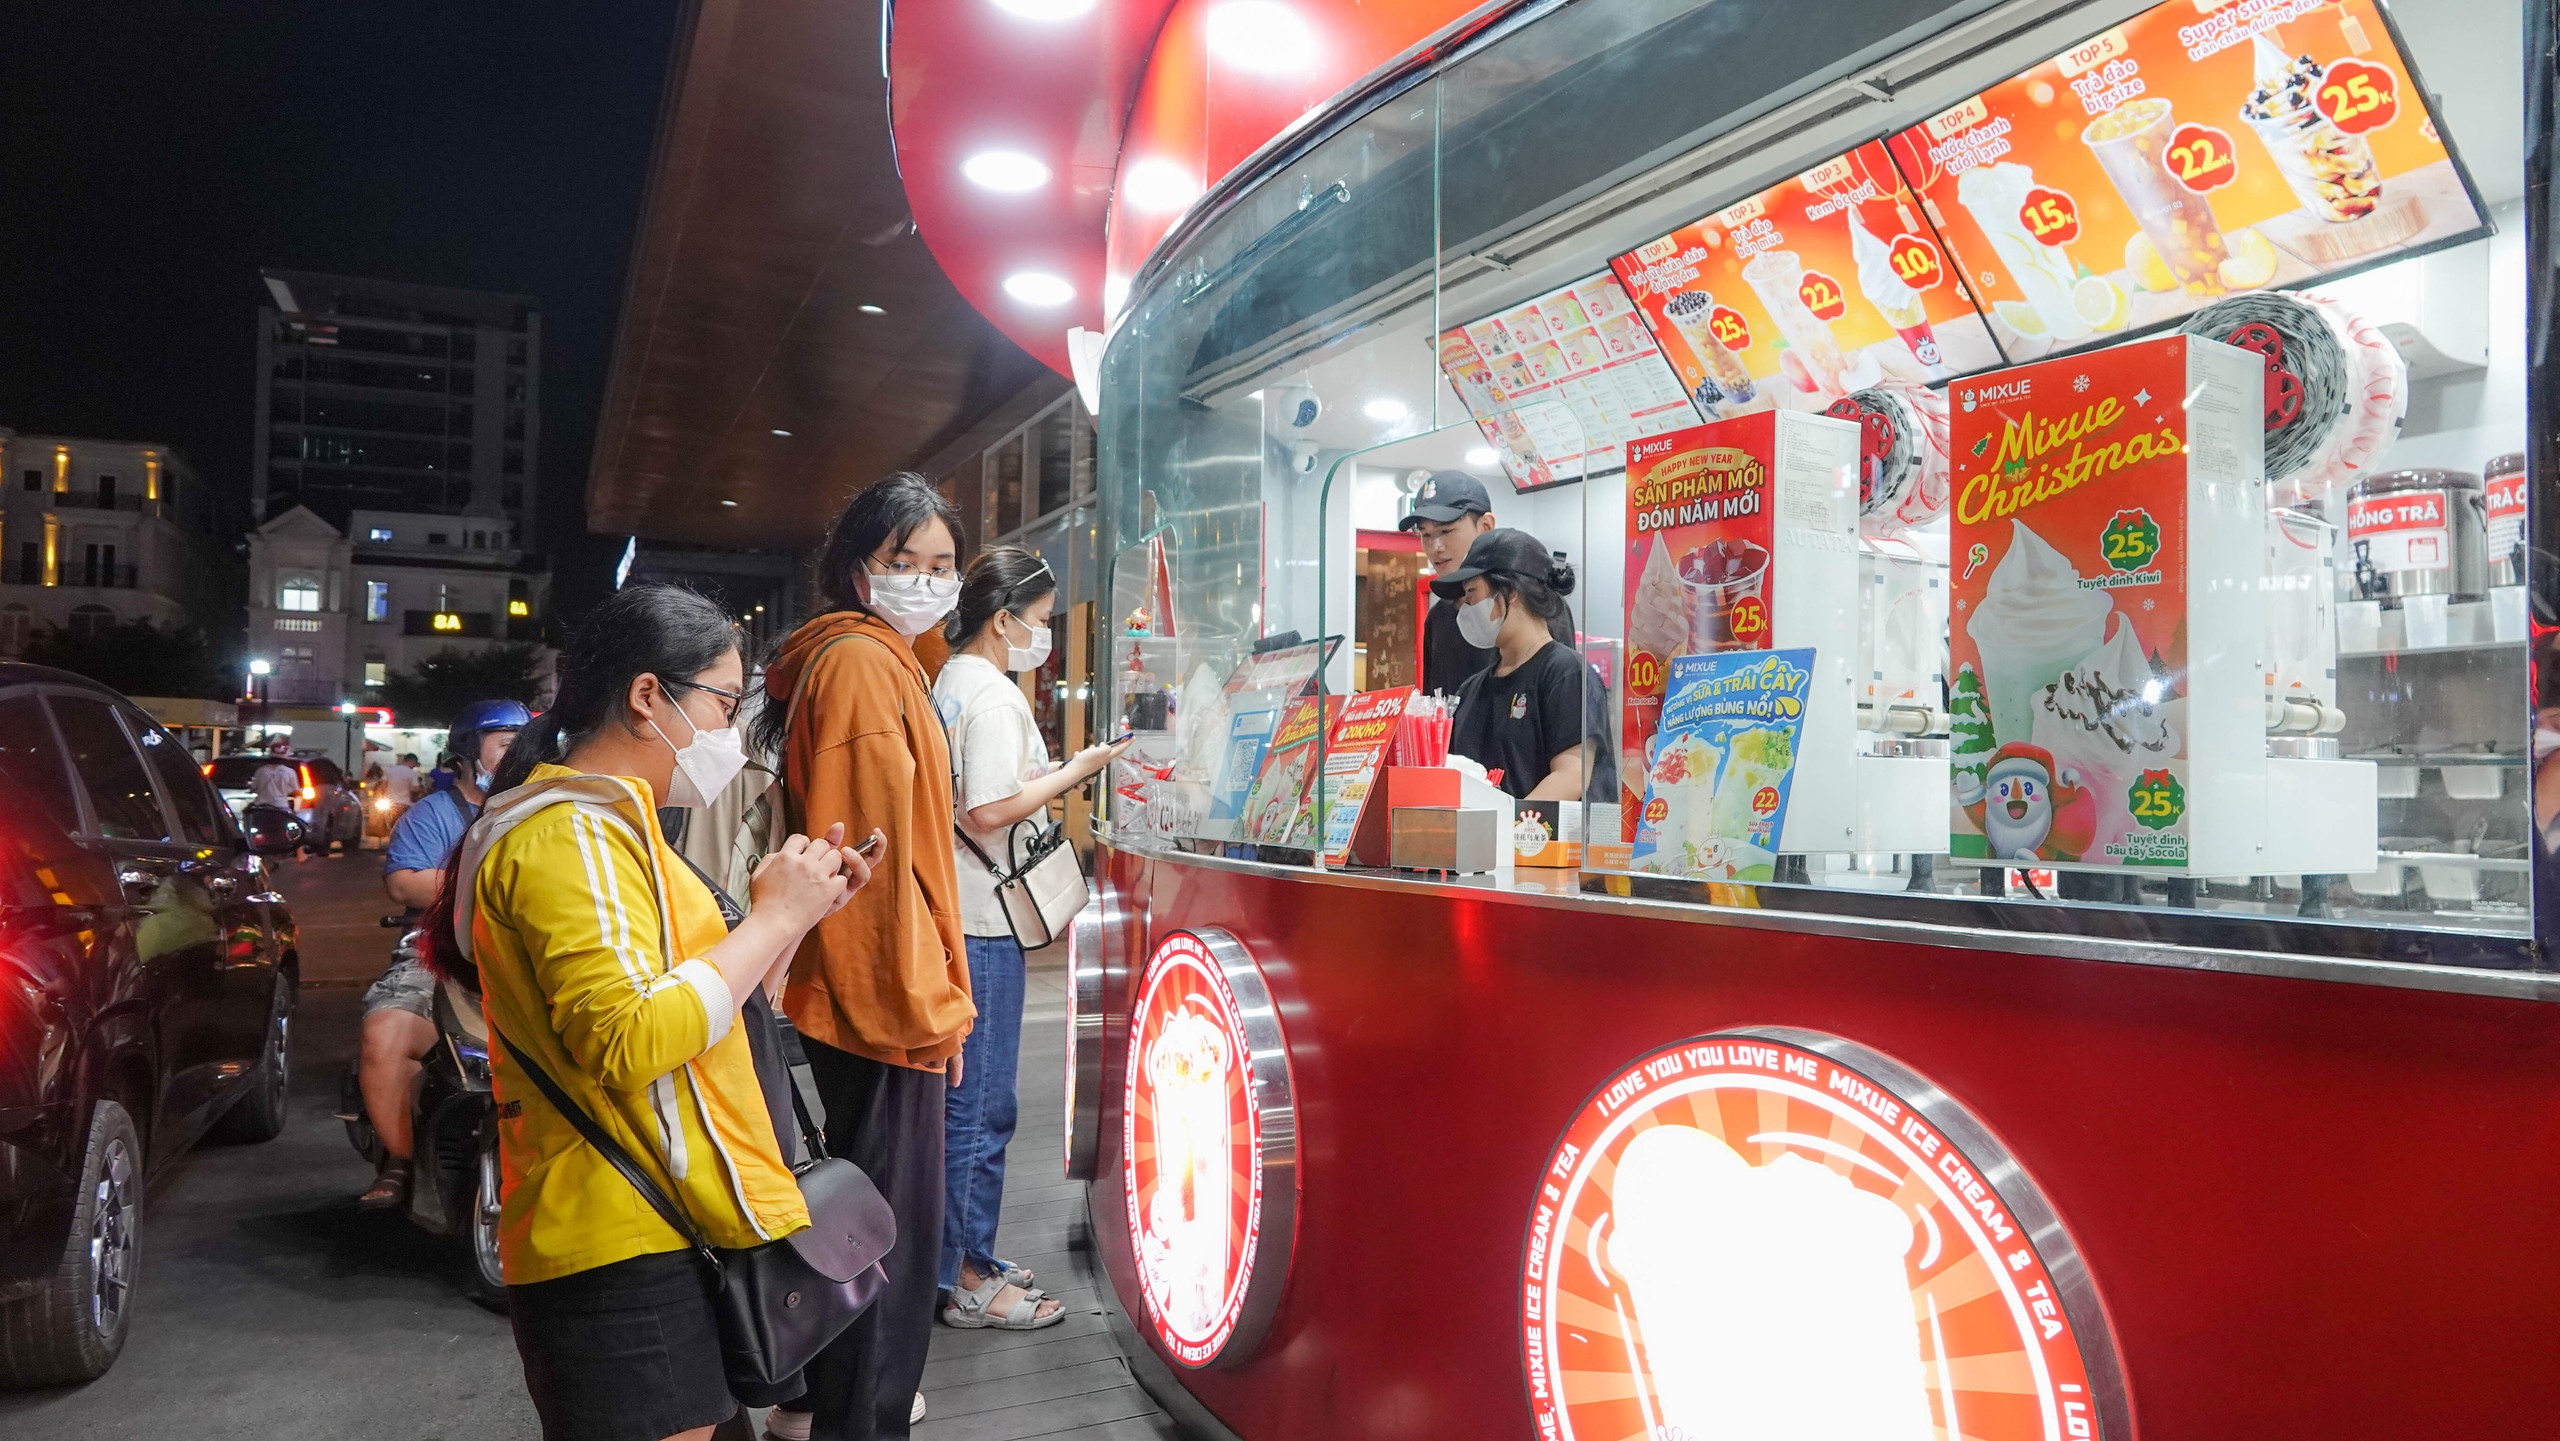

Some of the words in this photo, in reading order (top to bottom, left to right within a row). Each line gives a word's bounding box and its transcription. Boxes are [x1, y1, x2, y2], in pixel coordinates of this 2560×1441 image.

[2180, 12, 2236, 44] Super
[2069, 45, 2103, 67] TOP
[2103, 41, 2115, 53] 5
[2073, 76, 2104, 98] Trà
[2084, 79, 2145, 114] bigsize
[1937, 113, 1960, 132] TOP
[1961, 109, 1976, 124] 4
[1965, 118, 2010, 147] chanh
[1810, 168, 1833, 186] TOP
[1832, 163, 1842, 176] 3
[1727, 206, 1747, 221] TOP
[1747, 202, 1757, 214] 2
[1807, 203, 1834, 219] Kem
[1731, 225, 1752, 243] Trà
[1643, 244, 1662, 259] TOP
[1980, 378, 2032, 403] MIXUE
[1642, 438, 1673, 456] MIXUE
[1990, 397, 2126, 473] Mixue
[1661, 459, 1688, 477] HAPPY
[1689, 455, 1709, 467] NEW
[1710, 452, 1733, 464] YEAR
[1957, 428, 2181, 525] Christmas
[1634, 478, 1668, 508] SẢN
[1671, 468, 1724, 501] PHẨM
[1728, 461, 1765, 490] MỚI
[1638, 502, 1675, 532] ĐÓN
[1679, 497, 1719, 526] NĂM
[1724, 488, 1761, 516] MỚI
[2396, 500, 2440, 523] TRÀ
[2488, 489, 2514, 511] TRÀ
[2077, 575, 2107, 590] Tuyết
[2135, 571, 2161, 585] Kiwi
[1685, 660, 1718, 673] MIXUE
[1713, 683, 1722, 695] &
[1723, 671, 1756, 694] TRÁI
[1759, 665, 1802, 692] CÂY
[1372, 697, 1404, 718] 50%
[1714, 697, 1745, 715] BÙNG
[2106, 844, 2127, 855] Dâu
[2128, 844, 2147, 858] tây
[2148, 845, 2185, 858] Socola
[2126, 832, 2158, 847] Tuyết
[1230, 1001, 1249, 1056] CREAM
[1553, 1142, 1580, 1181] TEA
[1544, 1182, 1560, 1202] &
[1597, 1101, 1609, 1117] I
[1605, 1071, 1647, 1110] LOVE
[1645, 1051, 1684, 1082] YOU
[1684, 1046, 1725, 1070] YOU
[1730, 1045, 1779, 1072] LOVE
[1784, 1051, 1818, 1082] ME
[1829, 1068, 1901, 1125] MIXUE
[1901, 1116, 1939, 1159] ICE
[1936, 1152, 2014, 1244] CREAM
[2007, 1248, 2032, 1273] &
[2026, 1278, 2063, 1342] TEA
[1526, 1205, 1554, 1280] CREAM
[1526, 1283, 1543, 1322] ICE
[1527, 1325, 1549, 1398] MIXUE
[2060, 1383, 2082, 1393] I
[2063, 1401, 2091, 1441] LO
